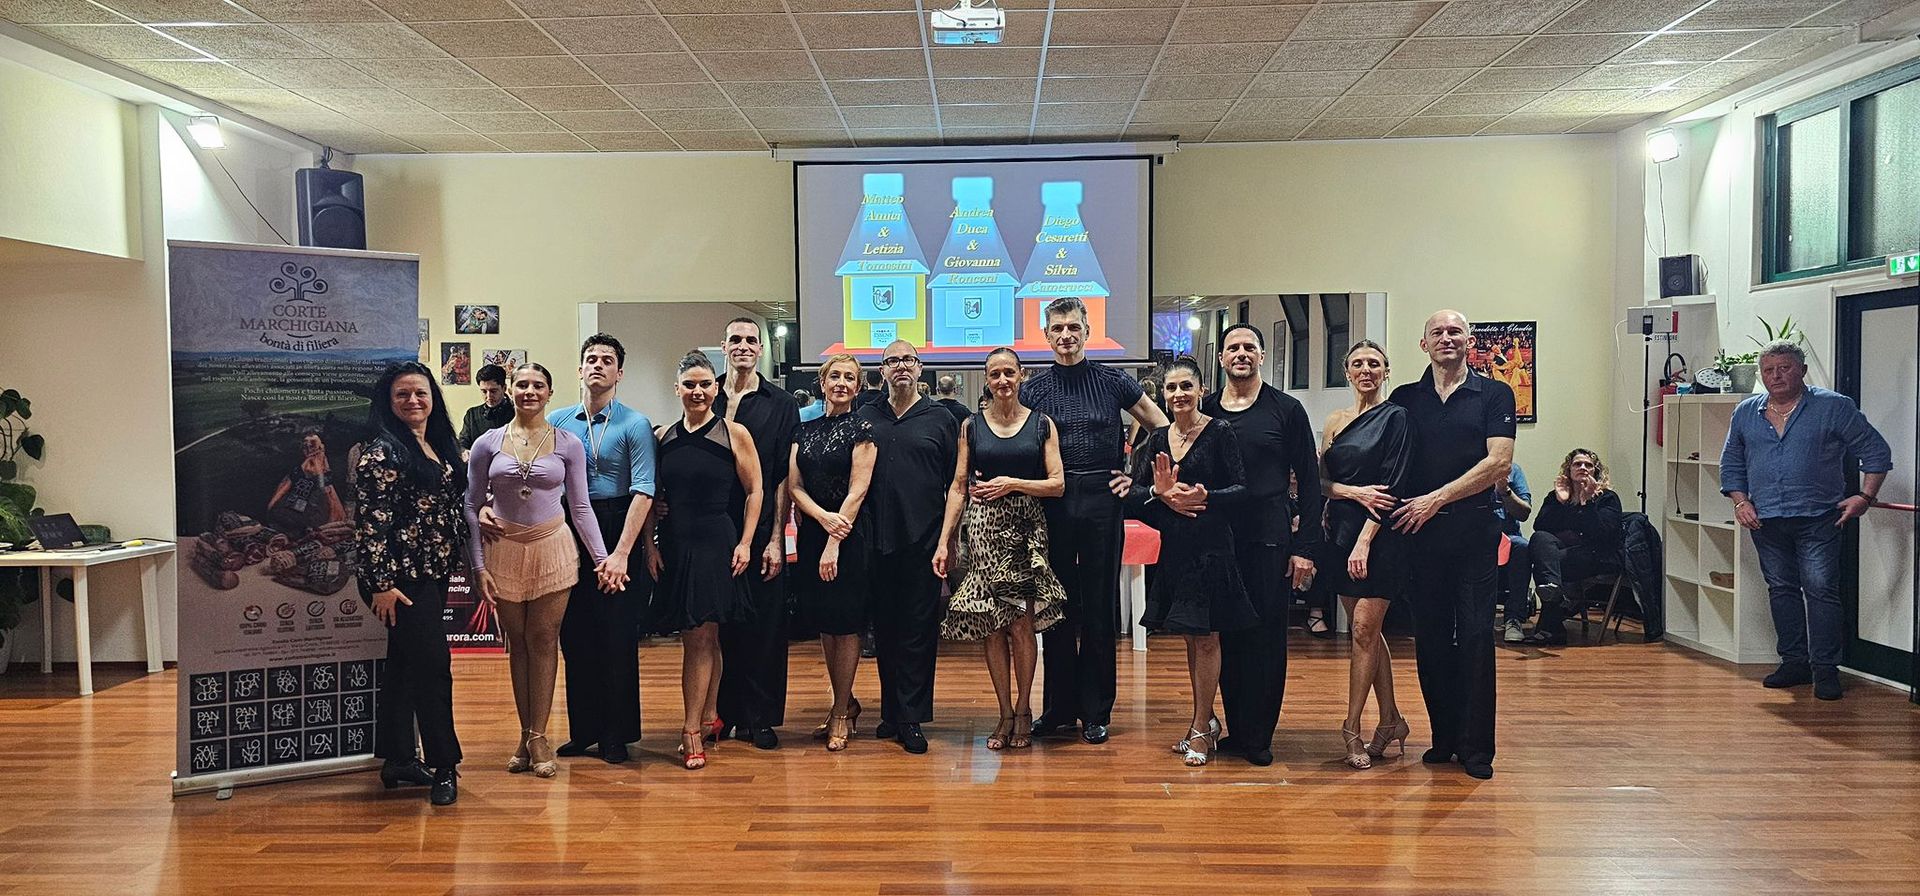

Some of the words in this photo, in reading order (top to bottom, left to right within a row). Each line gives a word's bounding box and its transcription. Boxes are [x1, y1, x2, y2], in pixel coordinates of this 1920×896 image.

[861, 193, 905, 205] Matteo
[865, 210, 903, 221] Amici
[949, 206, 994, 218] Andrea
[1043, 215, 1080, 228] Diego
[878, 226, 890, 238] &
[956, 223, 988, 234] Duca
[1035, 231, 1089, 242] Cesaretti
[862, 243, 905, 255] Letizia
[966, 240, 979, 252] &
[1055, 247, 1068, 259] &
[944, 256, 1001, 268] Giovanna
[1044, 264, 1078, 276] Silvia
[947, 273, 998, 285] Ronconi
[272, 304, 327, 318] CORTE
[240, 318, 359, 333] MARCHIGIANA
[1470, 324, 1499, 332] Benedetto
[1506, 323, 1533, 332] Claudia
[260, 332, 292, 350] bontà
[292, 341, 304, 351] di
[306, 337, 340, 351] filiera
[448, 585, 471, 594] ncing
[280, 670, 292, 679] FA
[313, 665, 332, 676] ASC
[239, 673, 260, 683] COR
[351, 677, 367, 687] NO
[280, 684, 295, 693] NO
[314, 680, 329, 690] NO
[235, 688, 251, 697] NO
[308, 699, 331, 709] VEN
[344, 696, 364, 706] COR
[197, 710, 219, 721] PAN
[236, 706, 257, 716] PAN
[198, 719, 218, 728] CET
[236, 714, 256, 724] CET
[281, 718, 292, 726] LE
[201, 726, 212, 735] TA
[239, 721, 251, 730] TA
[348, 728, 364, 737] NA
[246, 739, 260, 749] LO
[274, 737, 298, 750] LON
[310, 733, 332, 746] LON
[348, 734, 363, 744] PO
[196, 745, 214, 754] SAL
[280, 746, 298, 758] ZA
[314, 742, 332, 754] ZA
[244, 753, 260, 763] NO
